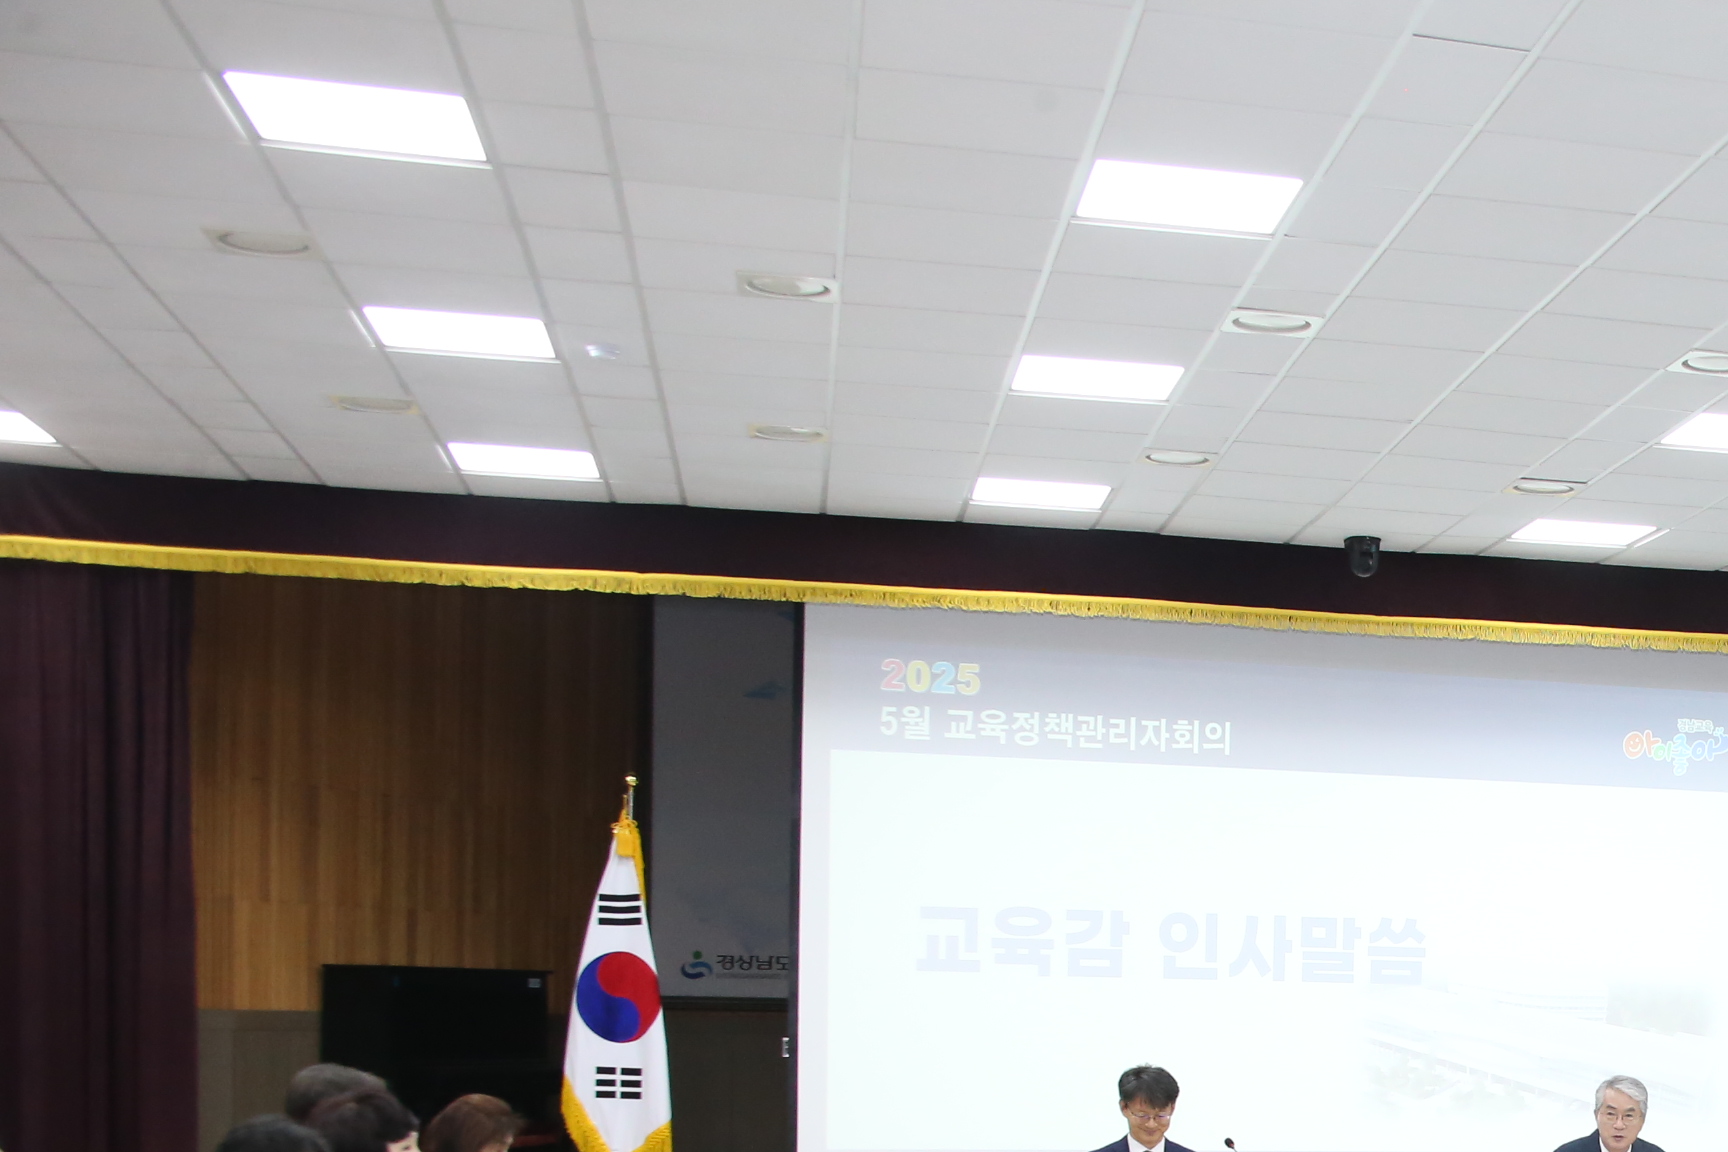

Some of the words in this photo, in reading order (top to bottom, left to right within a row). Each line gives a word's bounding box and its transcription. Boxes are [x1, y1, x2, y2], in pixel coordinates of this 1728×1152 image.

[880, 658, 981, 696] 2025
[880, 706, 931, 741] 5월
[944, 708, 1232, 755] 교육정책관리자회의
[1677, 719, 1714, 734] 경남교육
[916, 906, 1131, 978] 교육감
[1158, 911, 1427, 985] 인사말씀
